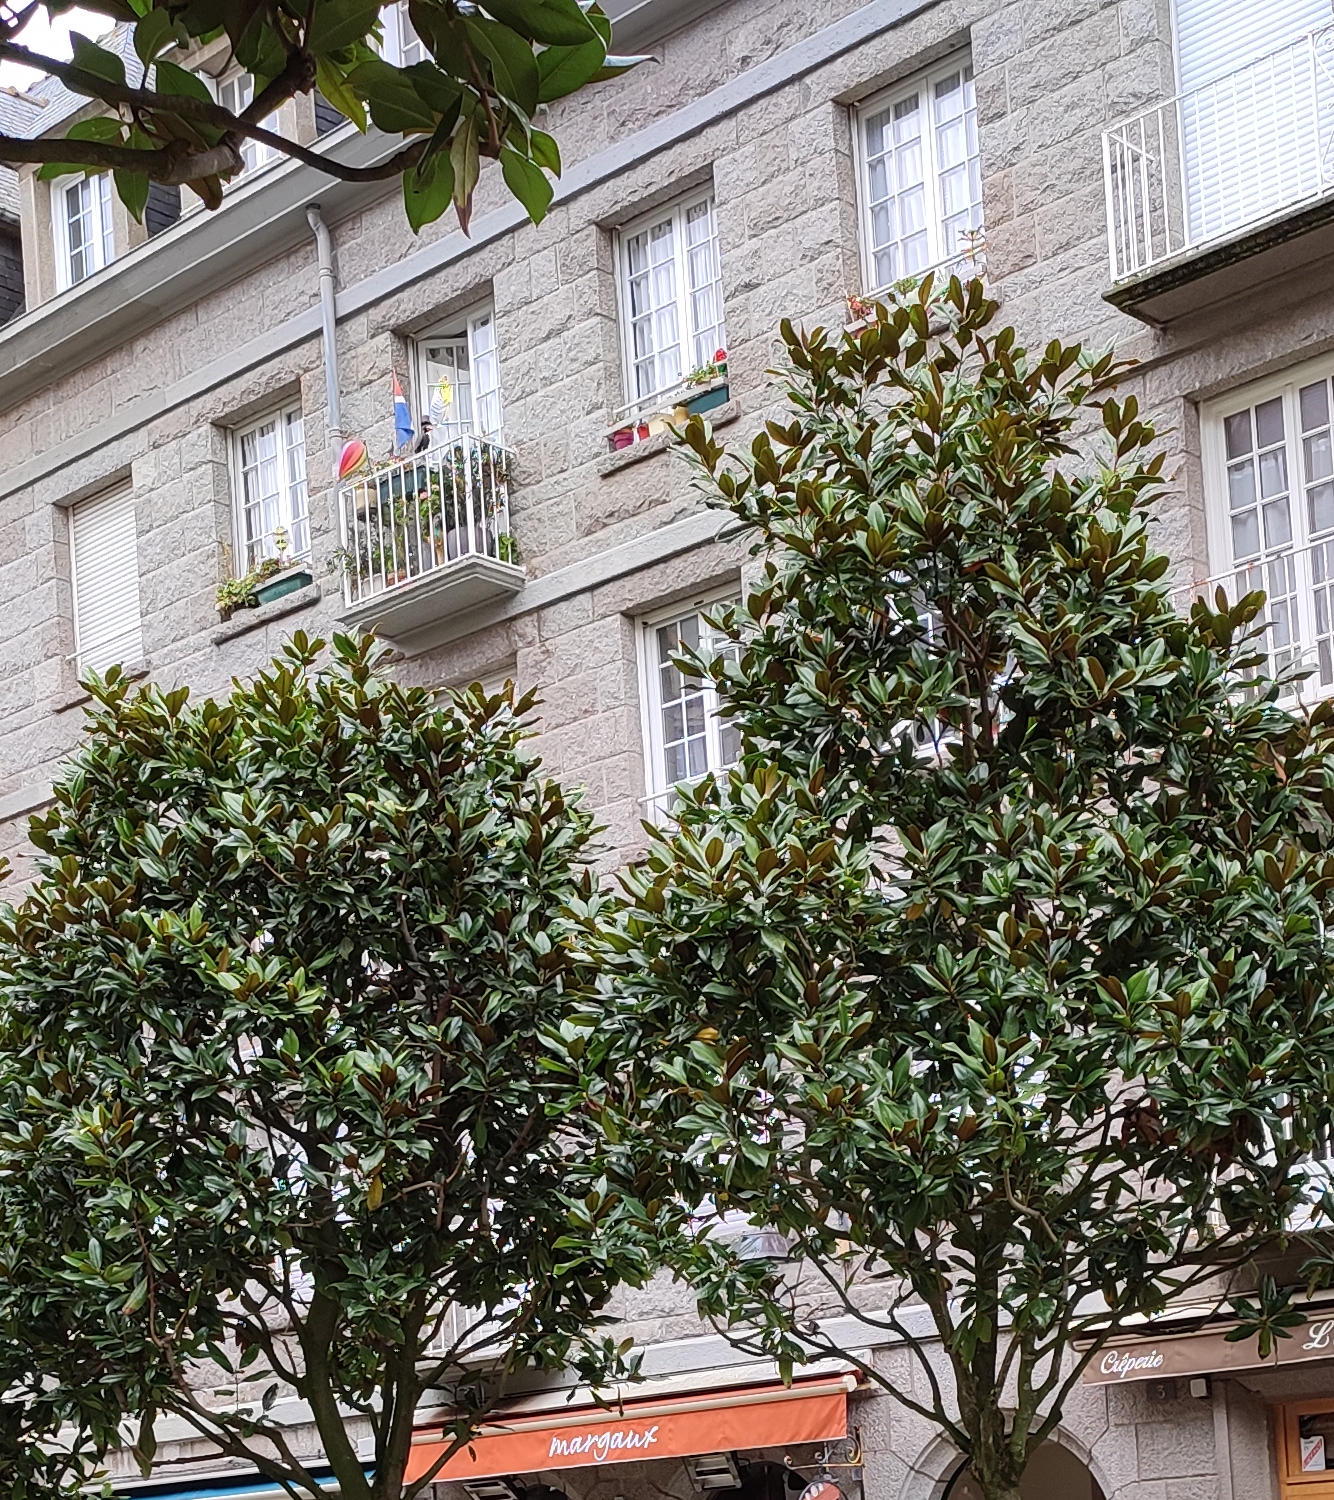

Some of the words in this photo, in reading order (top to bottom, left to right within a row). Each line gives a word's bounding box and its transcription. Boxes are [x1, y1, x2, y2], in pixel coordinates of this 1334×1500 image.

[1100, 1350, 1164, 1378] Crêperie
[1157, 1385, 1166, 1399] 3
[549, 1426, 659, 1461] margaux
